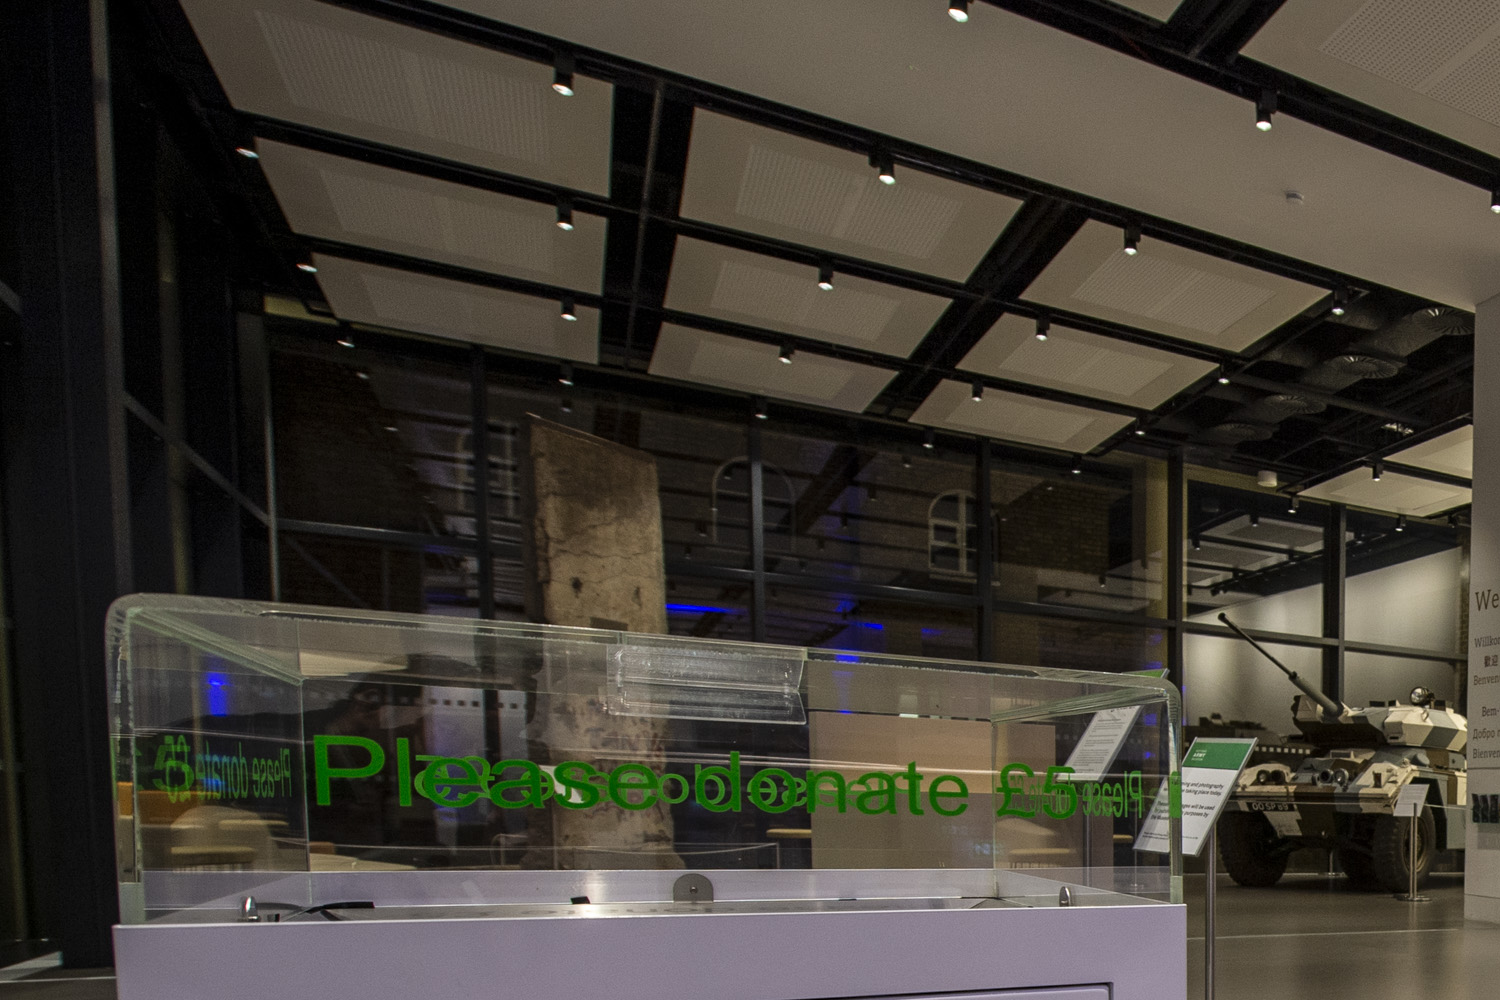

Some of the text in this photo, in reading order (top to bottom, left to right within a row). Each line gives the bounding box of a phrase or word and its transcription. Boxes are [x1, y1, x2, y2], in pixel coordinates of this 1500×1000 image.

[1473, 728, 1495, 740] Добро
[313, 734, 1078, 820] Please donate £5
